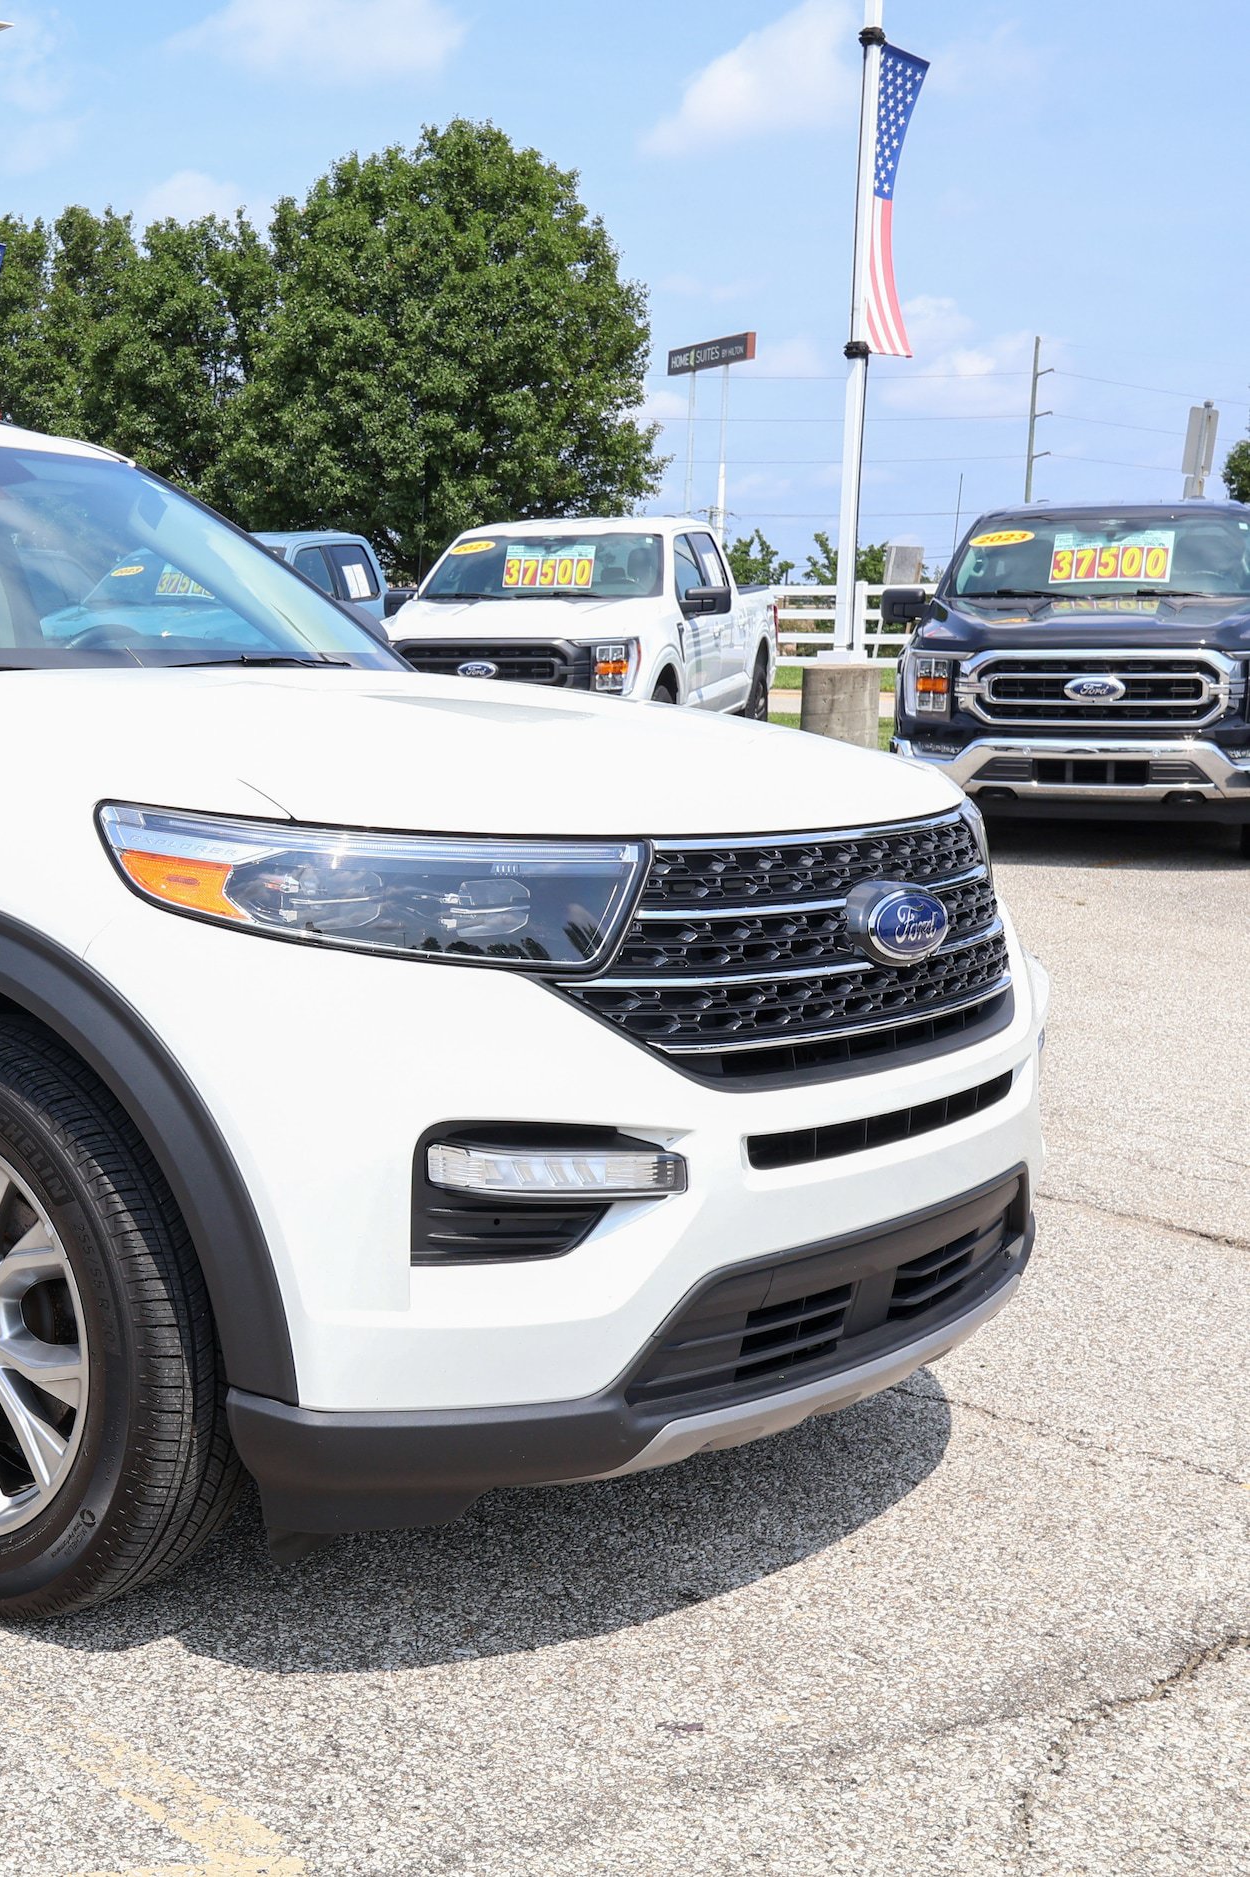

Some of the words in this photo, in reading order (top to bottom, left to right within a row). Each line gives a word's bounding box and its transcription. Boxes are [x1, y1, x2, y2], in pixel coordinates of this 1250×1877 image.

[695, 346, 720, 364] SUITES
[728, 345, 744, 357] HILTON
[976, 533, 1028, 545] 2023
[505, 559, 591, 585] 37500
[1053, 547, 1167, 580] 37500
[465, 665, 487, 676] Ford
[1080, 683, 1109, 695] Ford
[130, 834, 237, 857] EXPLORER
[895, 904, 939, 944] Ford
